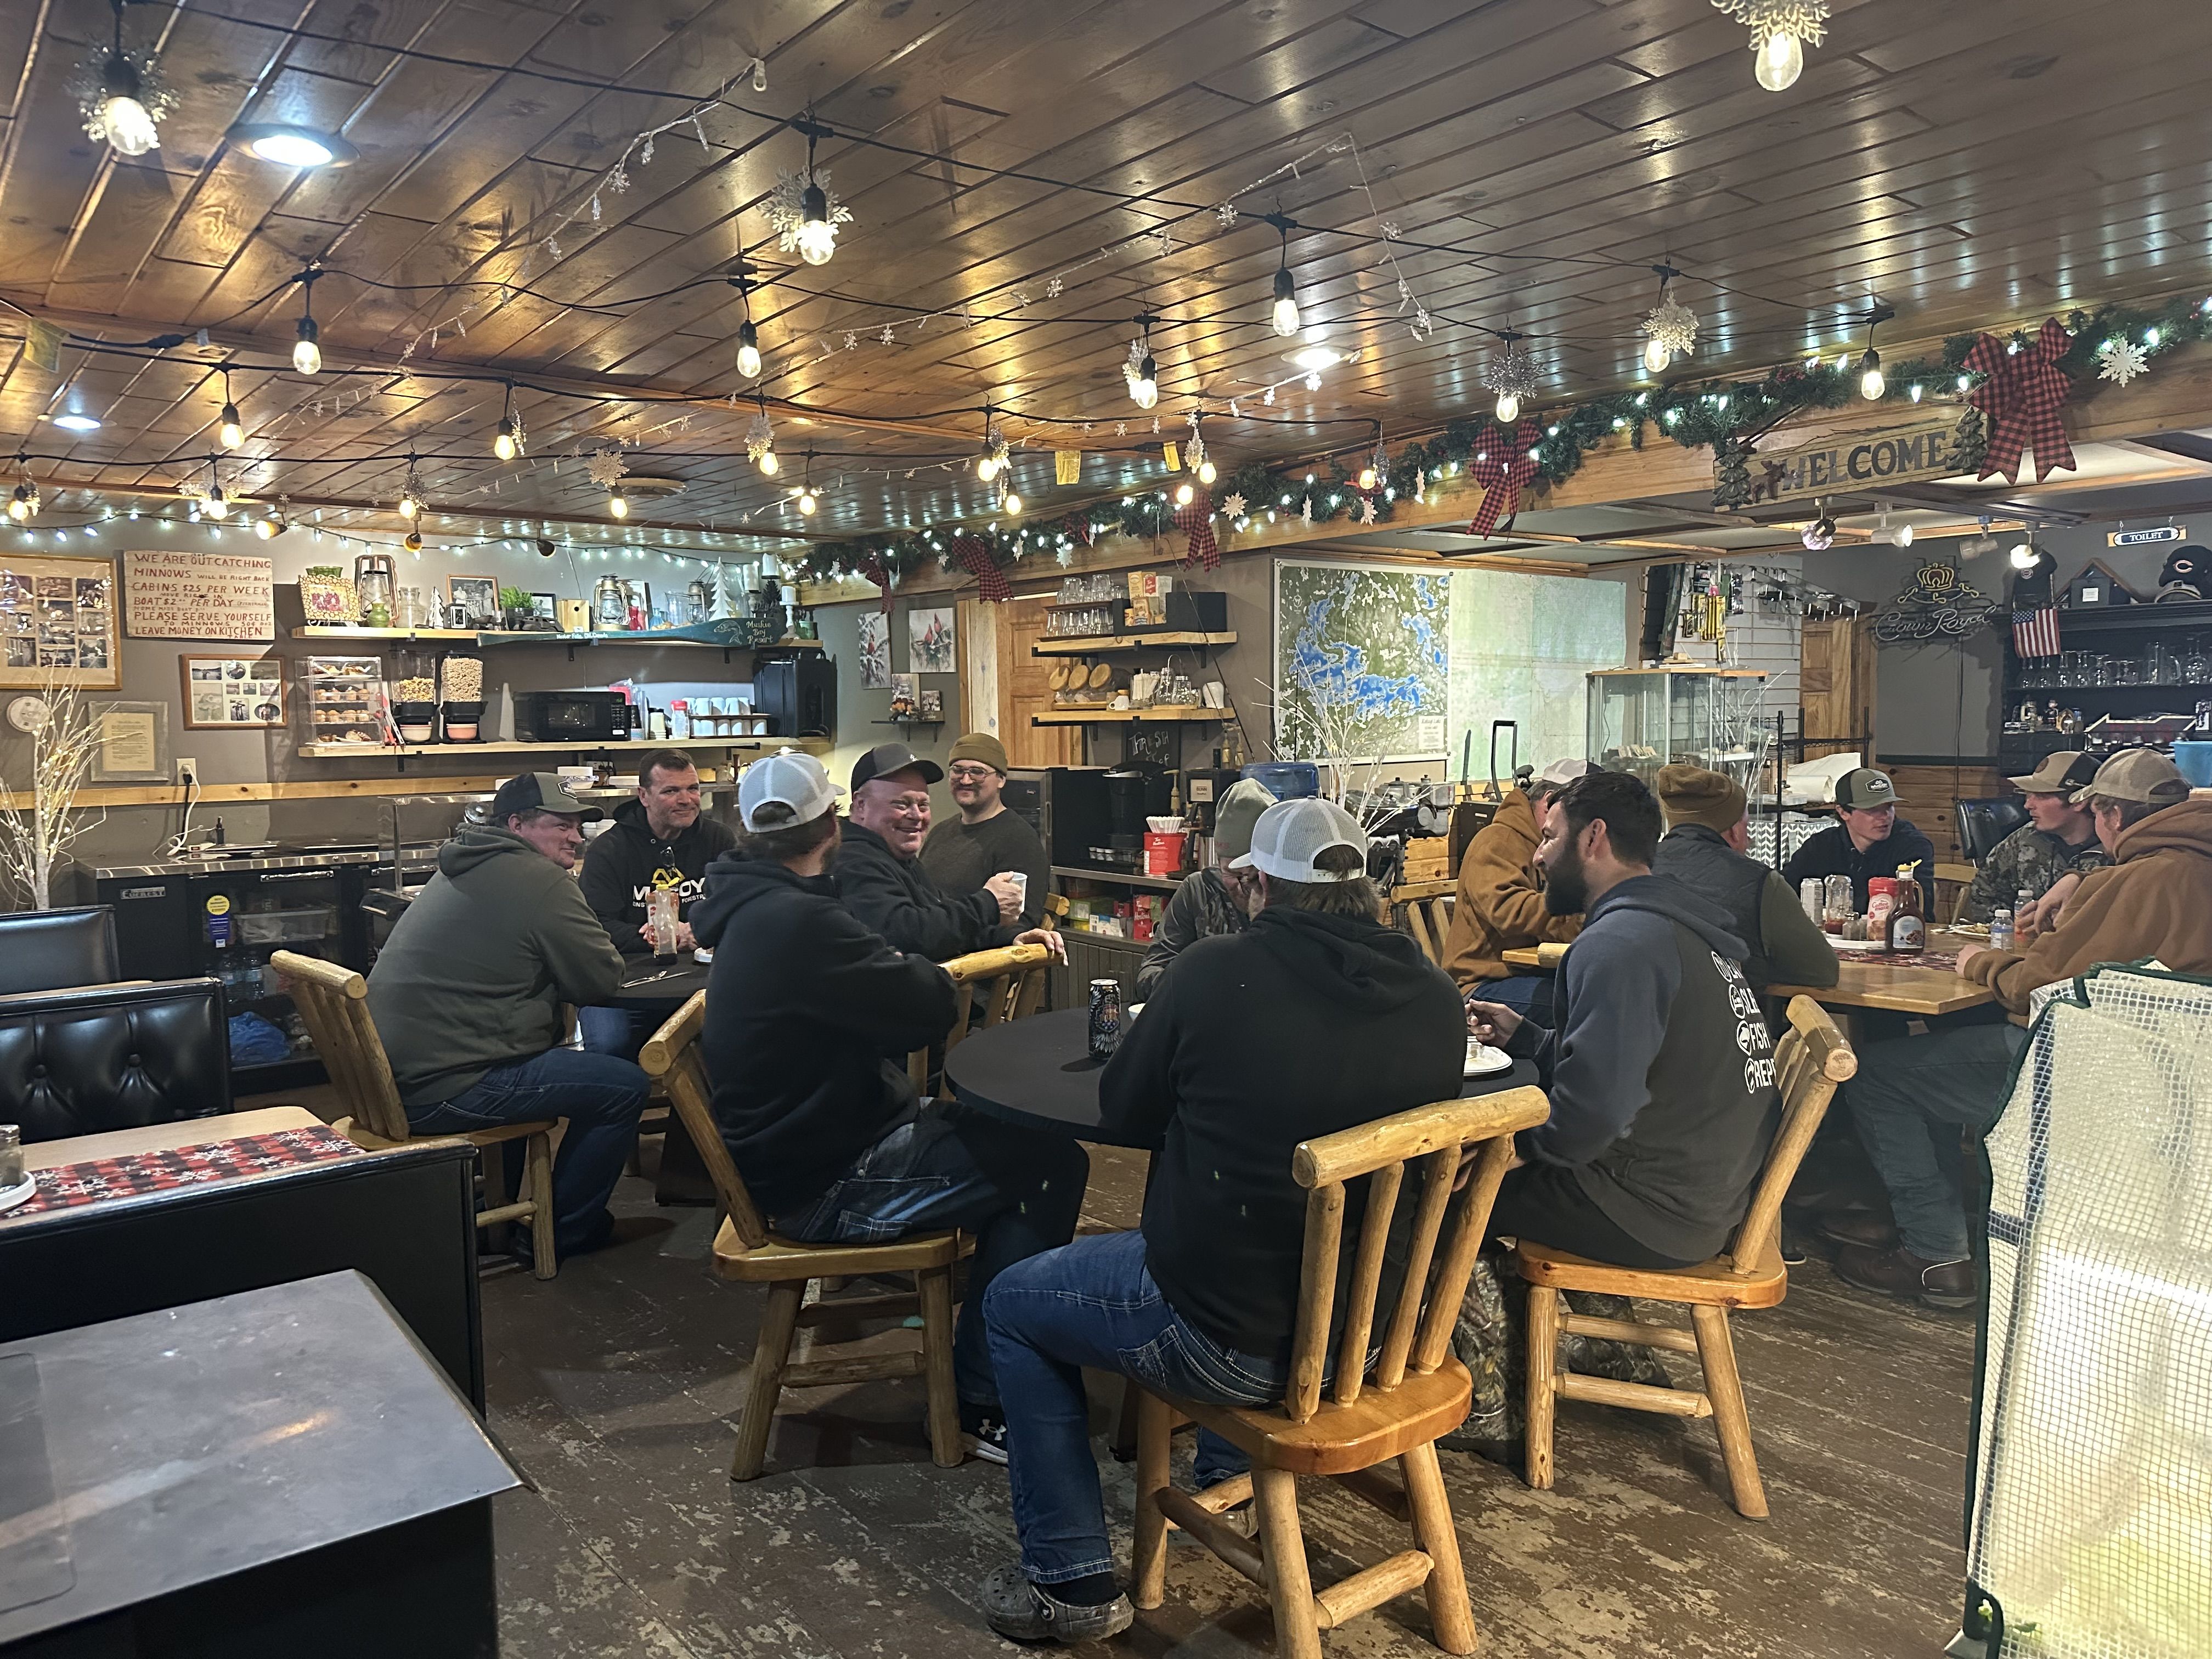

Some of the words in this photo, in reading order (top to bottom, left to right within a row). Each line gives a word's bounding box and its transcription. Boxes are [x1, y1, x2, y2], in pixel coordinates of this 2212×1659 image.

[1781, 431, 1948, 491] WELCOME
[2129, 531, 2164, 541] TOILET
[134, 554, 158, 563] WE
[162, 554, 186, 564] ARE
[191, 556, 213, 566] OUT
[215, 558, 271, 568] CATCHING
[134, 567, 191, 578] MINNOWS
[132, 582, 178, 592] CABINS
[183, 584, 201, 592] $25
[207, 585, 227, 593] PER
[233, 586, 269, 595] WEEK
[134, 596, 162, 605] BOAT
[190, 599, 210, 607] PER
[134, 612, 178, 620] PLEASE
[182, 612, 219, 621] SERVE
[224, 613, 272, 622] YOURSELF
[746, 620, 772, 628] Muskie
[1876, 611, 1933, 641] Crown
[1914, 605, 1997, 639] Royal
[136, 627, 165, 635] LEAVE
[168, 627, 202, 635] MONEY
[205, 627, 217, 635] ON
[219, 627, 262, 635] KITCHEN
[752, 628, 766, 637] Bay
[747, 635, 773, 644] Resort
[633, 877, 706, 901] MOY
[1748, 1022, 1771, 1051] FISH
